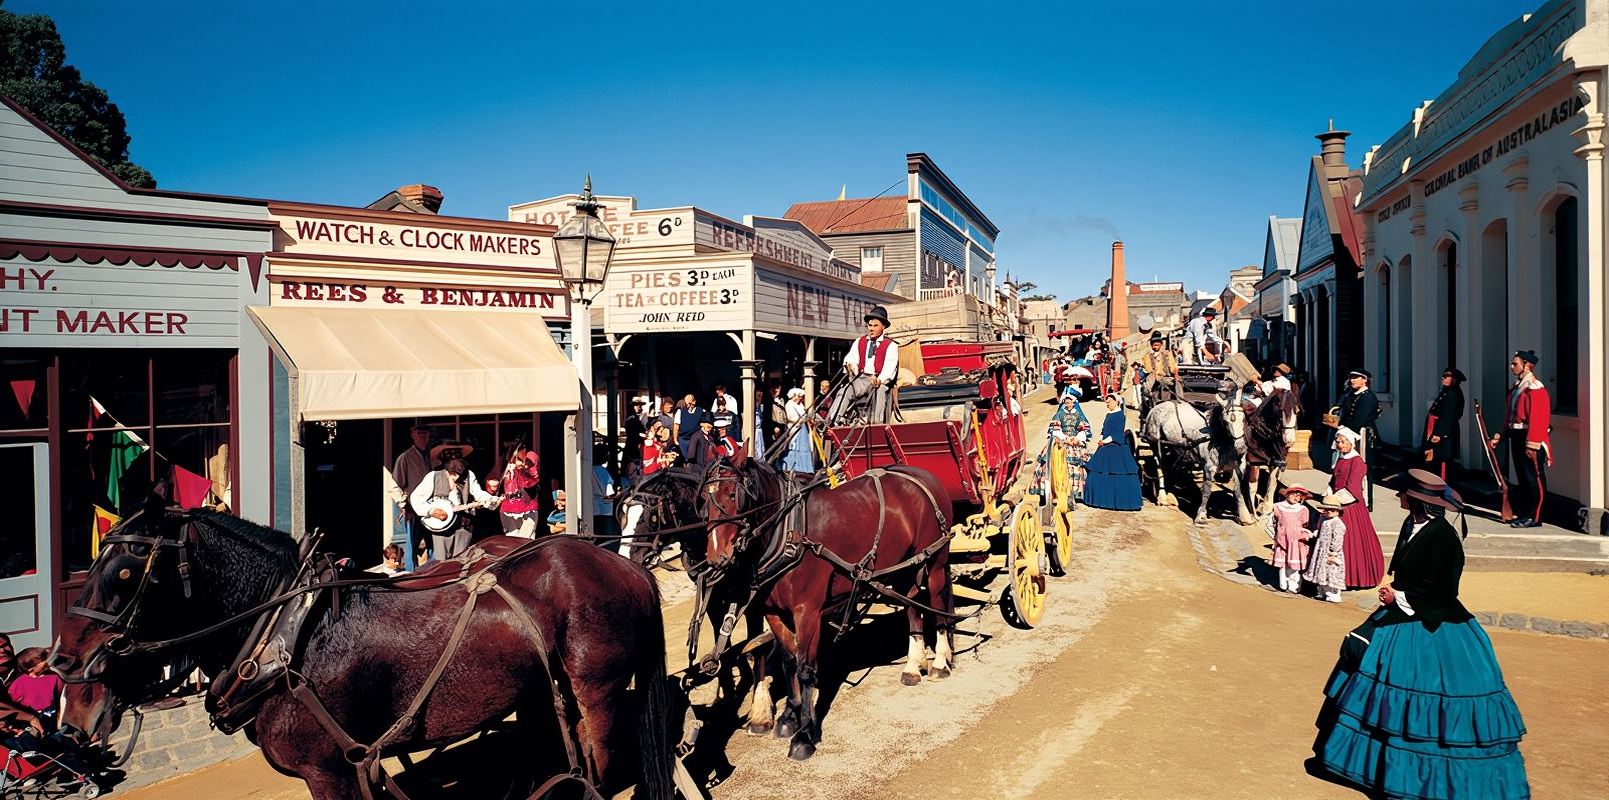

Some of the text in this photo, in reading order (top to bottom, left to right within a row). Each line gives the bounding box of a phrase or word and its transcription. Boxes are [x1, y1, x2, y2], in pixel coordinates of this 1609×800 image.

[1496, 95, 1584, 158] AUSTRALASIA
[525, 210, 570, 226] HOT
[295, 219, 541, 256] WATCH & CLOCK MAKERS
[712, 220, 813, 269] REFRESHMENT
[630, 272, 681, 288] PIES
[281, 280, 368, 302] REES
[381, 286, 405, 304] &
[420, 287, 555, 309] BENJAMIN
[616, 293, 645, 308] TEA
[660, 290, 718, 306] COFFEE
[787, 280, 830, 328] NEW
[56, 309, 188, 334] MAKER
[639, 312, 671, 323] JOHN
